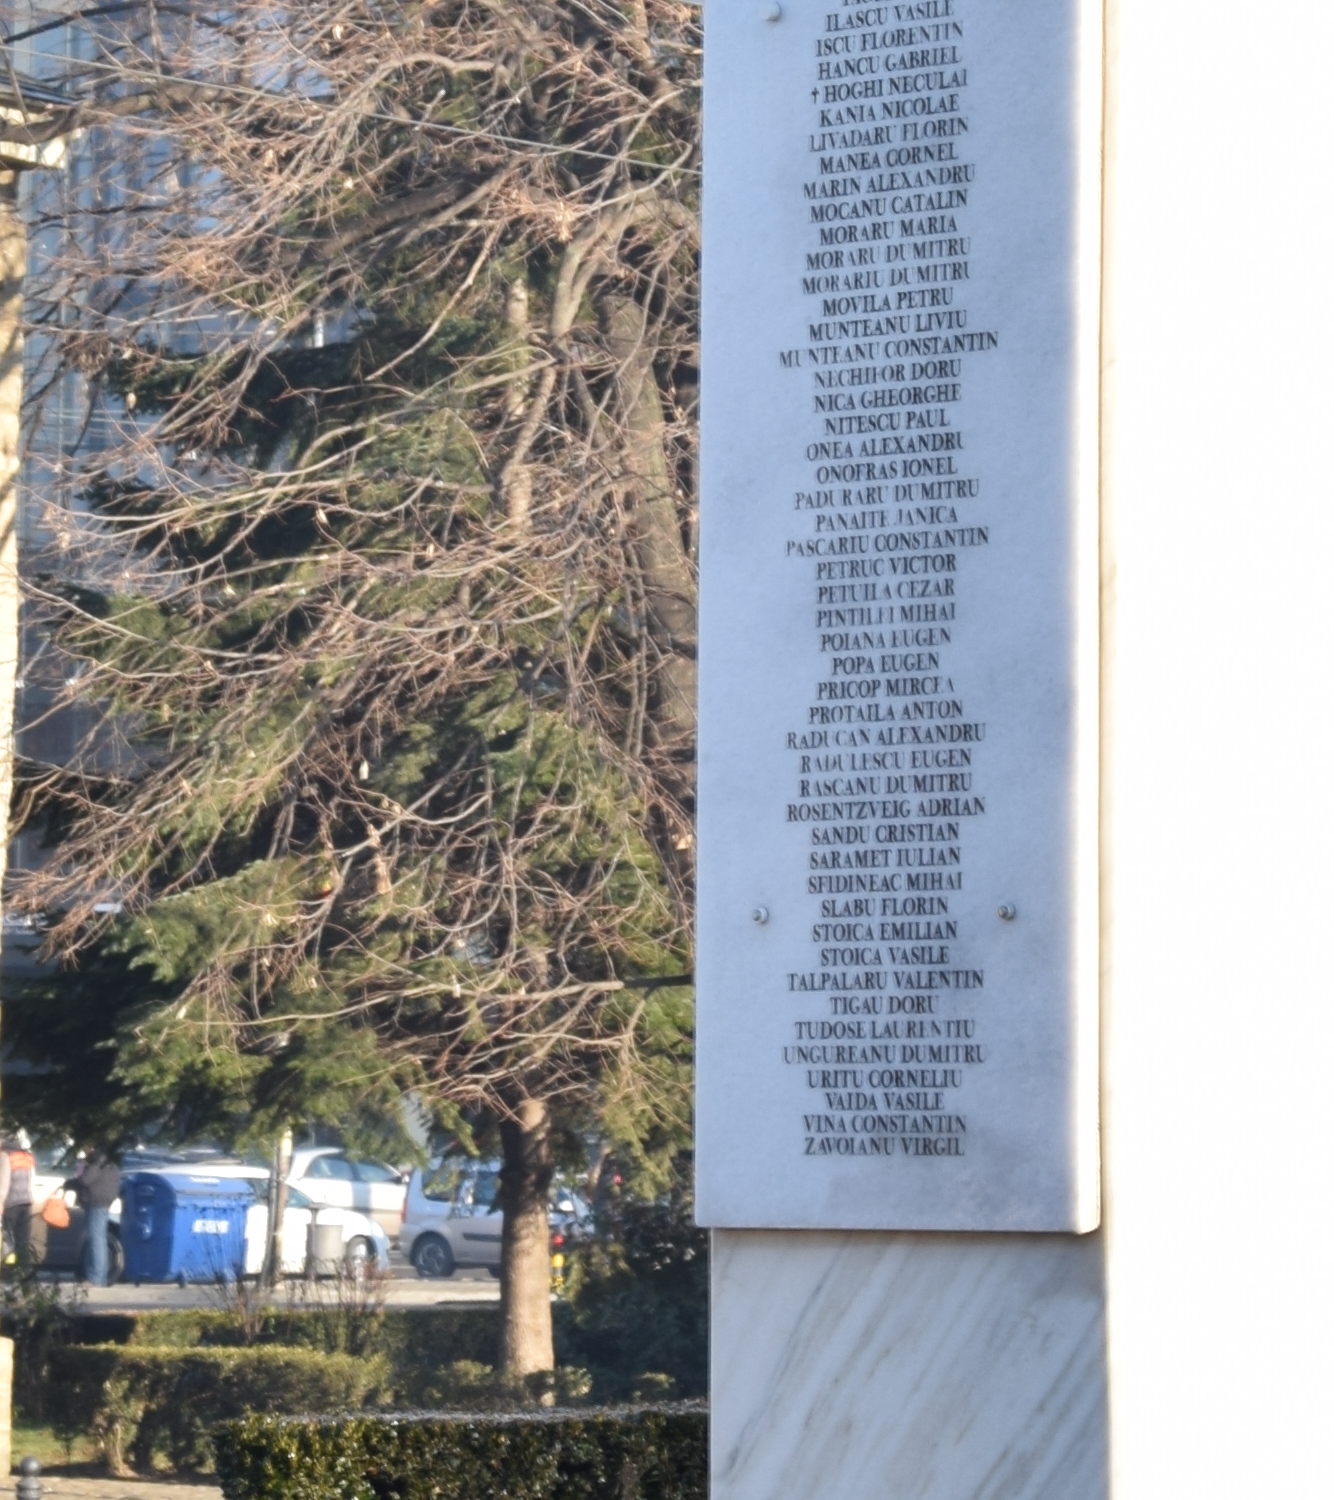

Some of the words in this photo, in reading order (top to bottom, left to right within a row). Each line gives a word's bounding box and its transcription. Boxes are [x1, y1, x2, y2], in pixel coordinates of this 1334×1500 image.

[824, 79, 883, 103] HOGHI
[889, 69, 968, 95] NECULAI
[820, 152, 881, 175] MANEA
[887, 142, 958, 167] CORNEL
[811, 197, 886, 223] MOCANU
[891, 189, 968, 214] CATALIN
[820, 221, 895, 246] MORARU
[900, 215, 957, 238] MARIA
[823, 294, 891, 317] MOVILA
[897, 287, 953, 310] PETRU
[809, 316, 910, 341] MUNTEANU
[915, 310, 967, 332] LIVIU
[815, 393, 856, 413] NICA
[861, 383, 962, 409] GHEORGHE
[825, 413, 901, 435] NITESCU
[906, 408, 950, 429] PAUL
[817, 461, 898, 484] ONOFRAS
[902, 456, 957, 478] IONEL
[889, 553, 956, 575] VICTOR
[832, 656, 874, 675] POPA
[881, 652, 939, 673] EUGEN
[901, 700, 963, 721] ANTON
[786, 800, 911, 822] ROSENTZVEIG
[917, 797, 986, 817] ADRIAN
[812, 826, 870, 845] SANDU
[875, 822, 960, 843] CRISTIAN
[810, 850, 892, 870] SARAMET
[897, 847, 961, 867] IULIAN
[808, 874, 902, 894] SFIDINEAC
[907, 872, 962, 891] MIHAI
[821, 899, 876, 918] SLABU
[881, 897, 949, 917] FLORIN
[812, 923, 874, 942] STOICA
[879, 921, 957, 941] EMILIAN
[820, 947, 883, 967] STOICA
[888, 946, 949, 965] VASILE
[787, 971, 888, 991] TALPALARU
[894, 970, 984, 990] VALENTIN
[803, 1114, 847, 1133] VINA
[851, 1114, 967, 1133] CONSTANTIN
